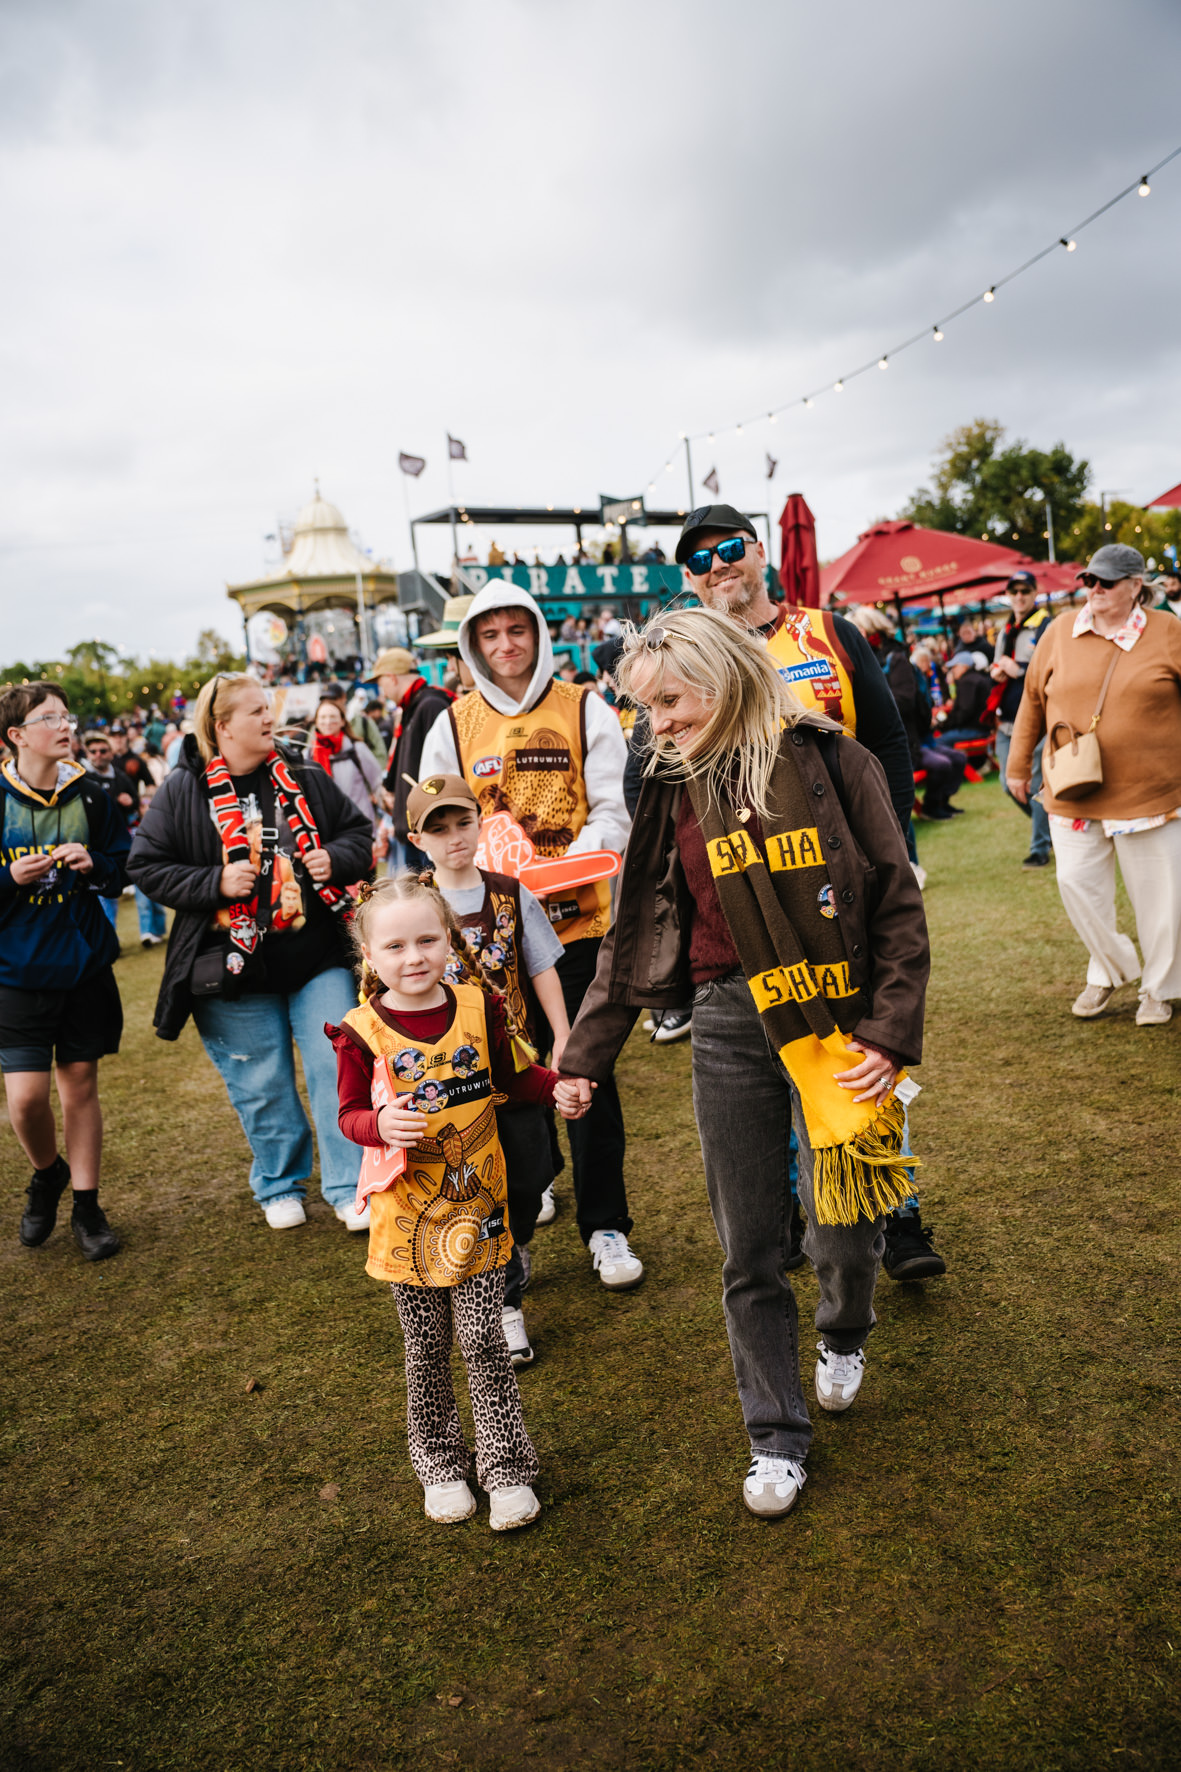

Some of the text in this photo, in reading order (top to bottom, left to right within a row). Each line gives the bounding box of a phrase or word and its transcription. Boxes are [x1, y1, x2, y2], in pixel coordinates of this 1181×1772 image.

[783, 663, 829, 681] smania
[516, 756, 569, 764] LUTRUWITA
[475, 762, 502, 775] AFL
